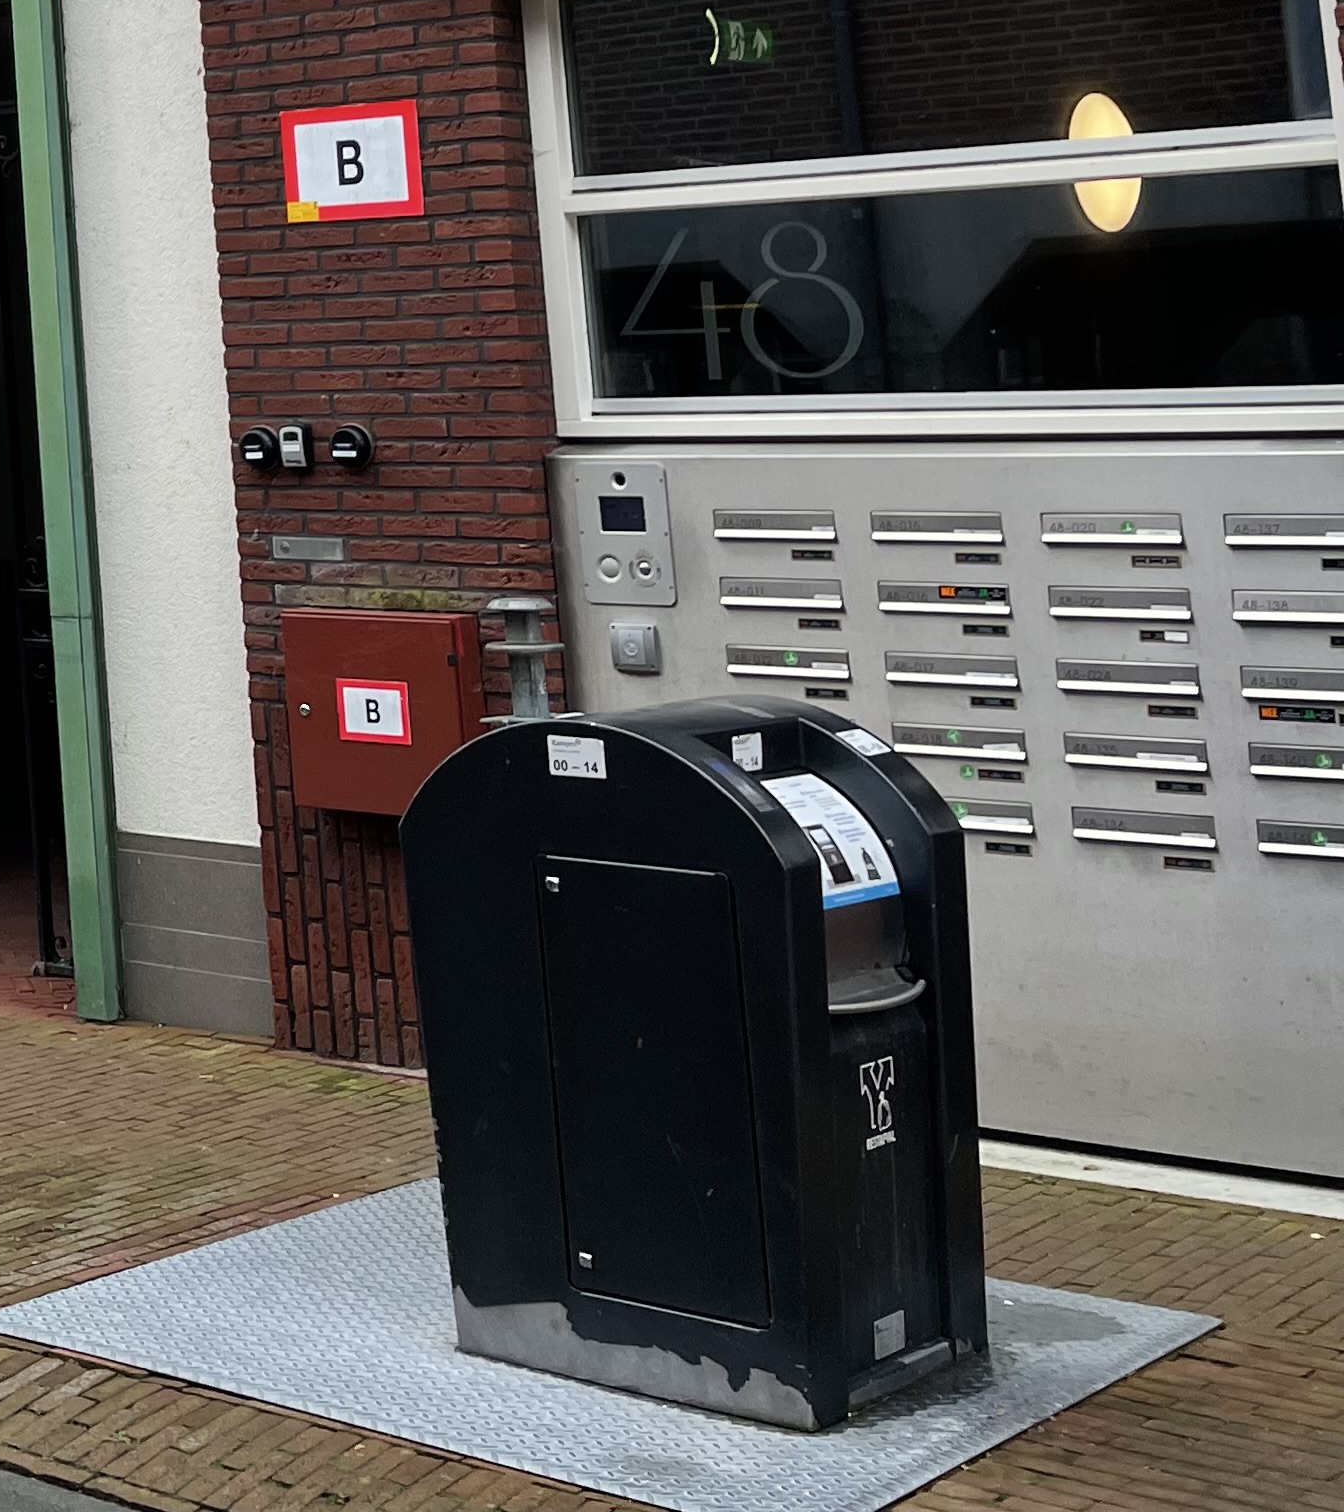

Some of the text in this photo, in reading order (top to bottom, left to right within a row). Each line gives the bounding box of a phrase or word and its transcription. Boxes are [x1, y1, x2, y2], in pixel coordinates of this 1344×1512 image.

[335, 139, 365, 186] B
[619, 219, 865, 382] 48
[1049, 522, 1097, 533] 48-020
[1241, 599, 1289, 611] 48-138
[1250, 676, 1298, 688] 48-139
[365, 699, 381, 724] B
[553, 759, 568, 771] 00
[584, 761, 599, 773] 14
